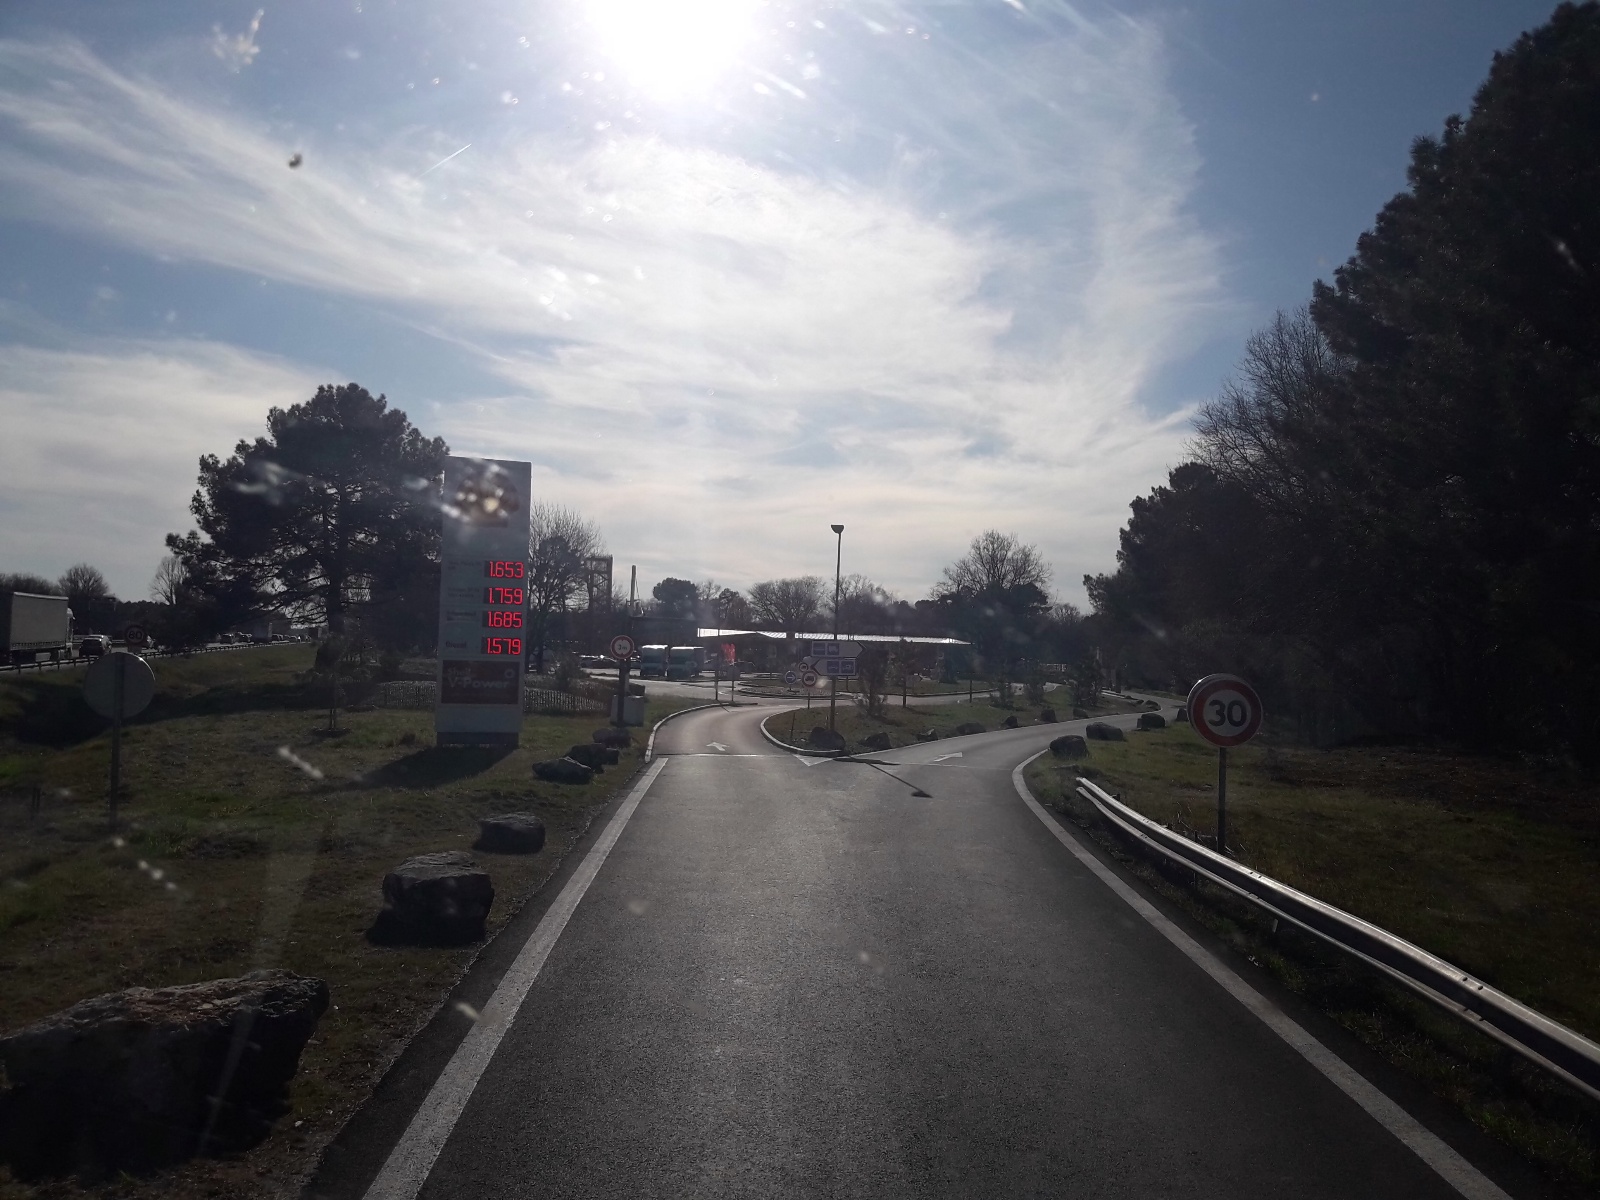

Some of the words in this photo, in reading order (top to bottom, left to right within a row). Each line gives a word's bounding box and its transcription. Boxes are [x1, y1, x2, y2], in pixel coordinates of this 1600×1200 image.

[490, 561, 524, 578] 1.653
[488, 587, 523, 605] 1.759
[488, 611, 522, 628] 1.685
[487, 637, 521, 655] 1.579
[1208, 699, 1247, 727] 30
